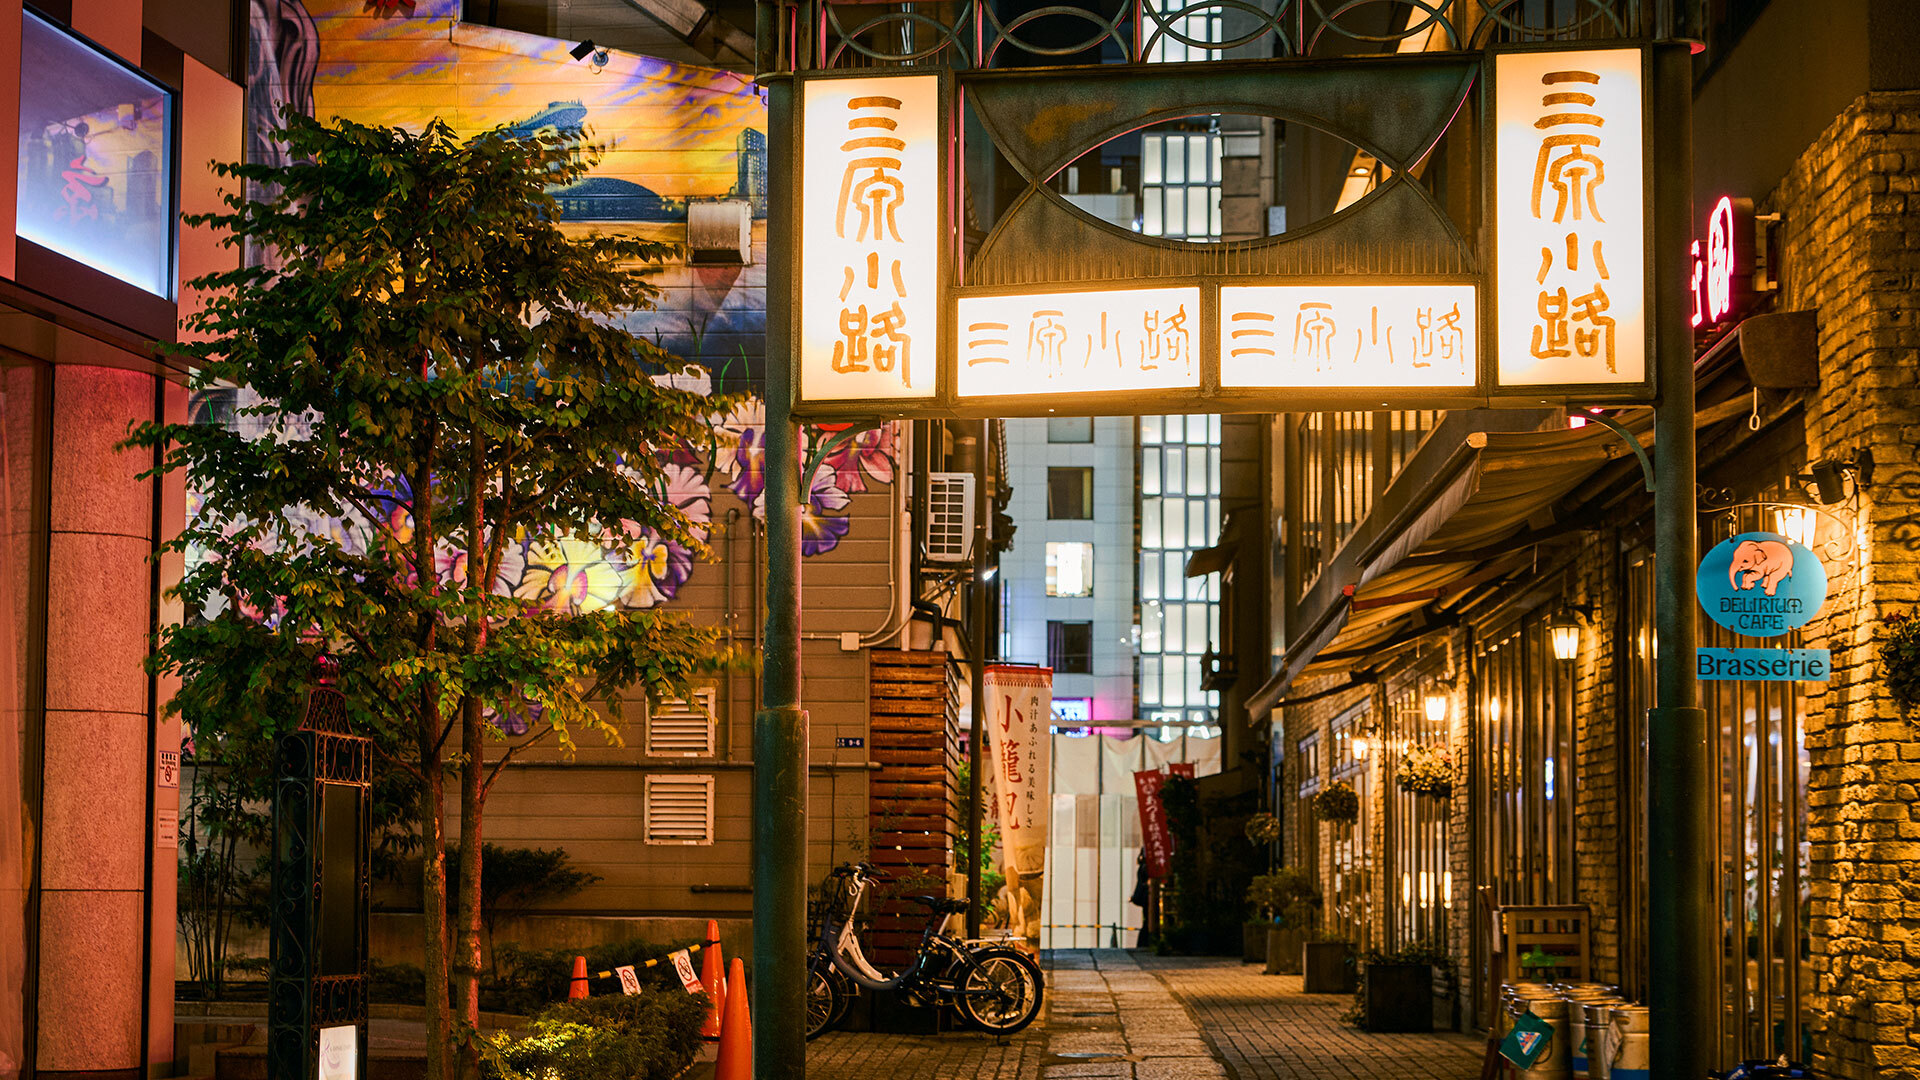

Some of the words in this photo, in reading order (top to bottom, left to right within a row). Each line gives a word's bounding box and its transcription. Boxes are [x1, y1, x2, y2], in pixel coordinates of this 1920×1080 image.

[832, 96, 912, 389] 三原小路
[1530, 70, 1618, 375] 三原小路
[968, 303, 1192, 379] 三原小路
[1231, 301, 1466, 377] 三原小路
[1720, 597, 1803, 613] DELIRIUM
[1738, 614, 1784, 630] CAFE
[1697, 653, 1823, 677] Brasserie
[1025, 695, 1040, 829] 肉汁あふれる美味しさ
